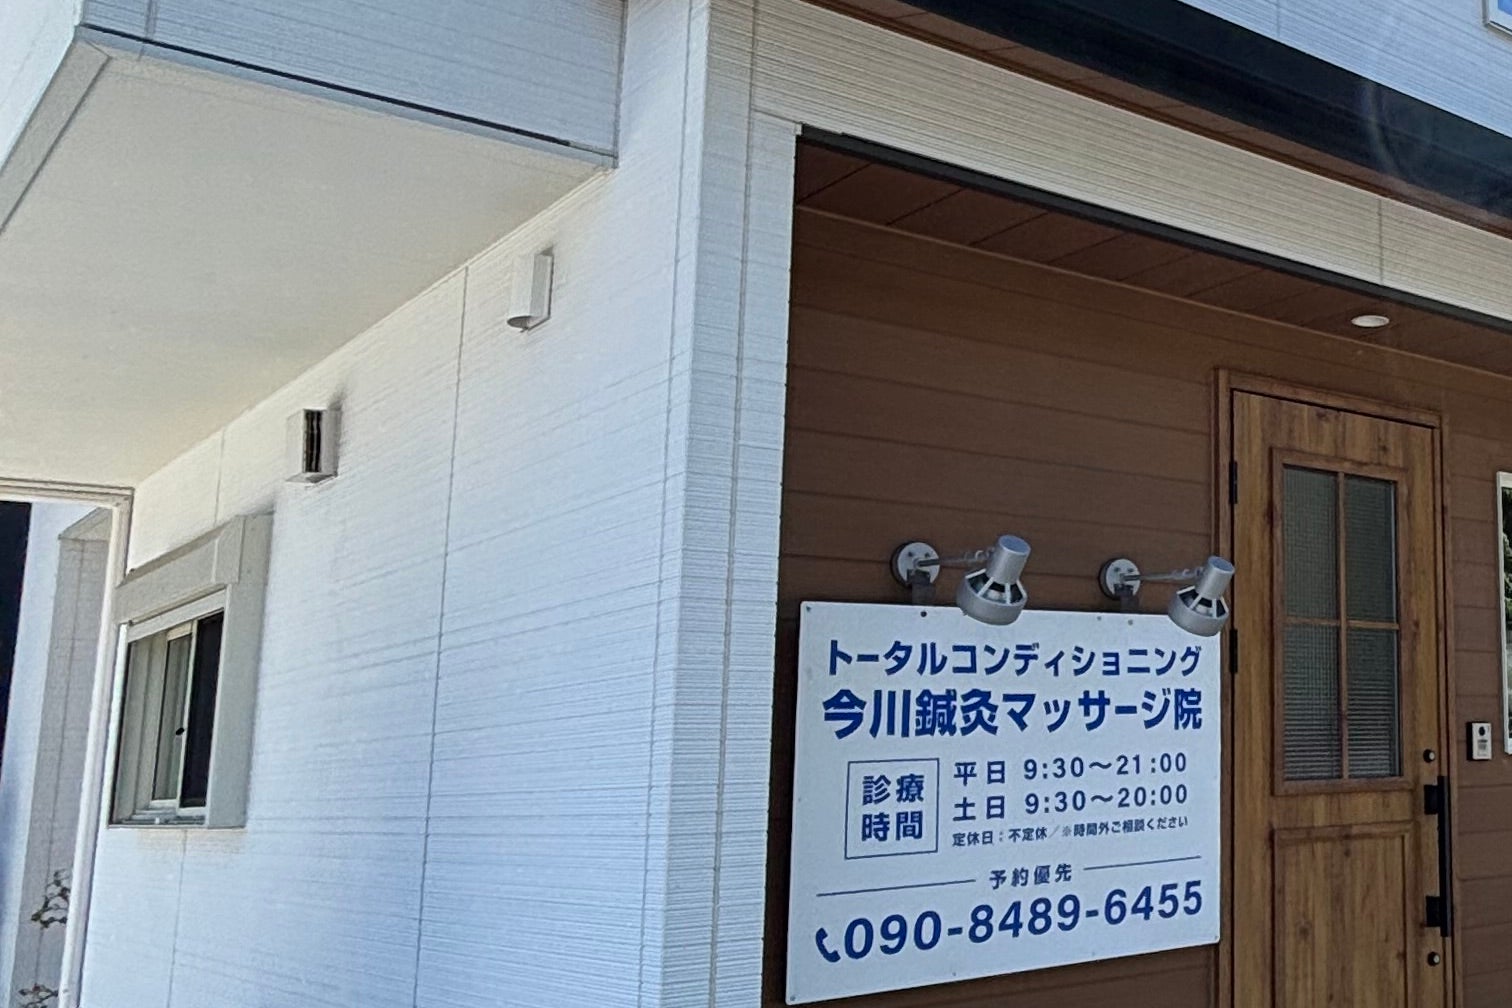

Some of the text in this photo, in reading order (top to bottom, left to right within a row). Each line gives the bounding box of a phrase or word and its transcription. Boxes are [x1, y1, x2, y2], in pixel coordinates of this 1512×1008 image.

[828, 639, 1202, 677] トータルコンディショニング
[822, 688, 1202, 740] 今川鍼灸マッサージ院
[862, 773, 925, 806] 診療
[953, 760, 1006, 787] 平日
[952, 795, 1006, 822] 土日
[861, 810, 923, 842] 時間
[988, 863, 1073, 891] 予約優先
[843, 879, 1203, 960] 090-8489-6455
